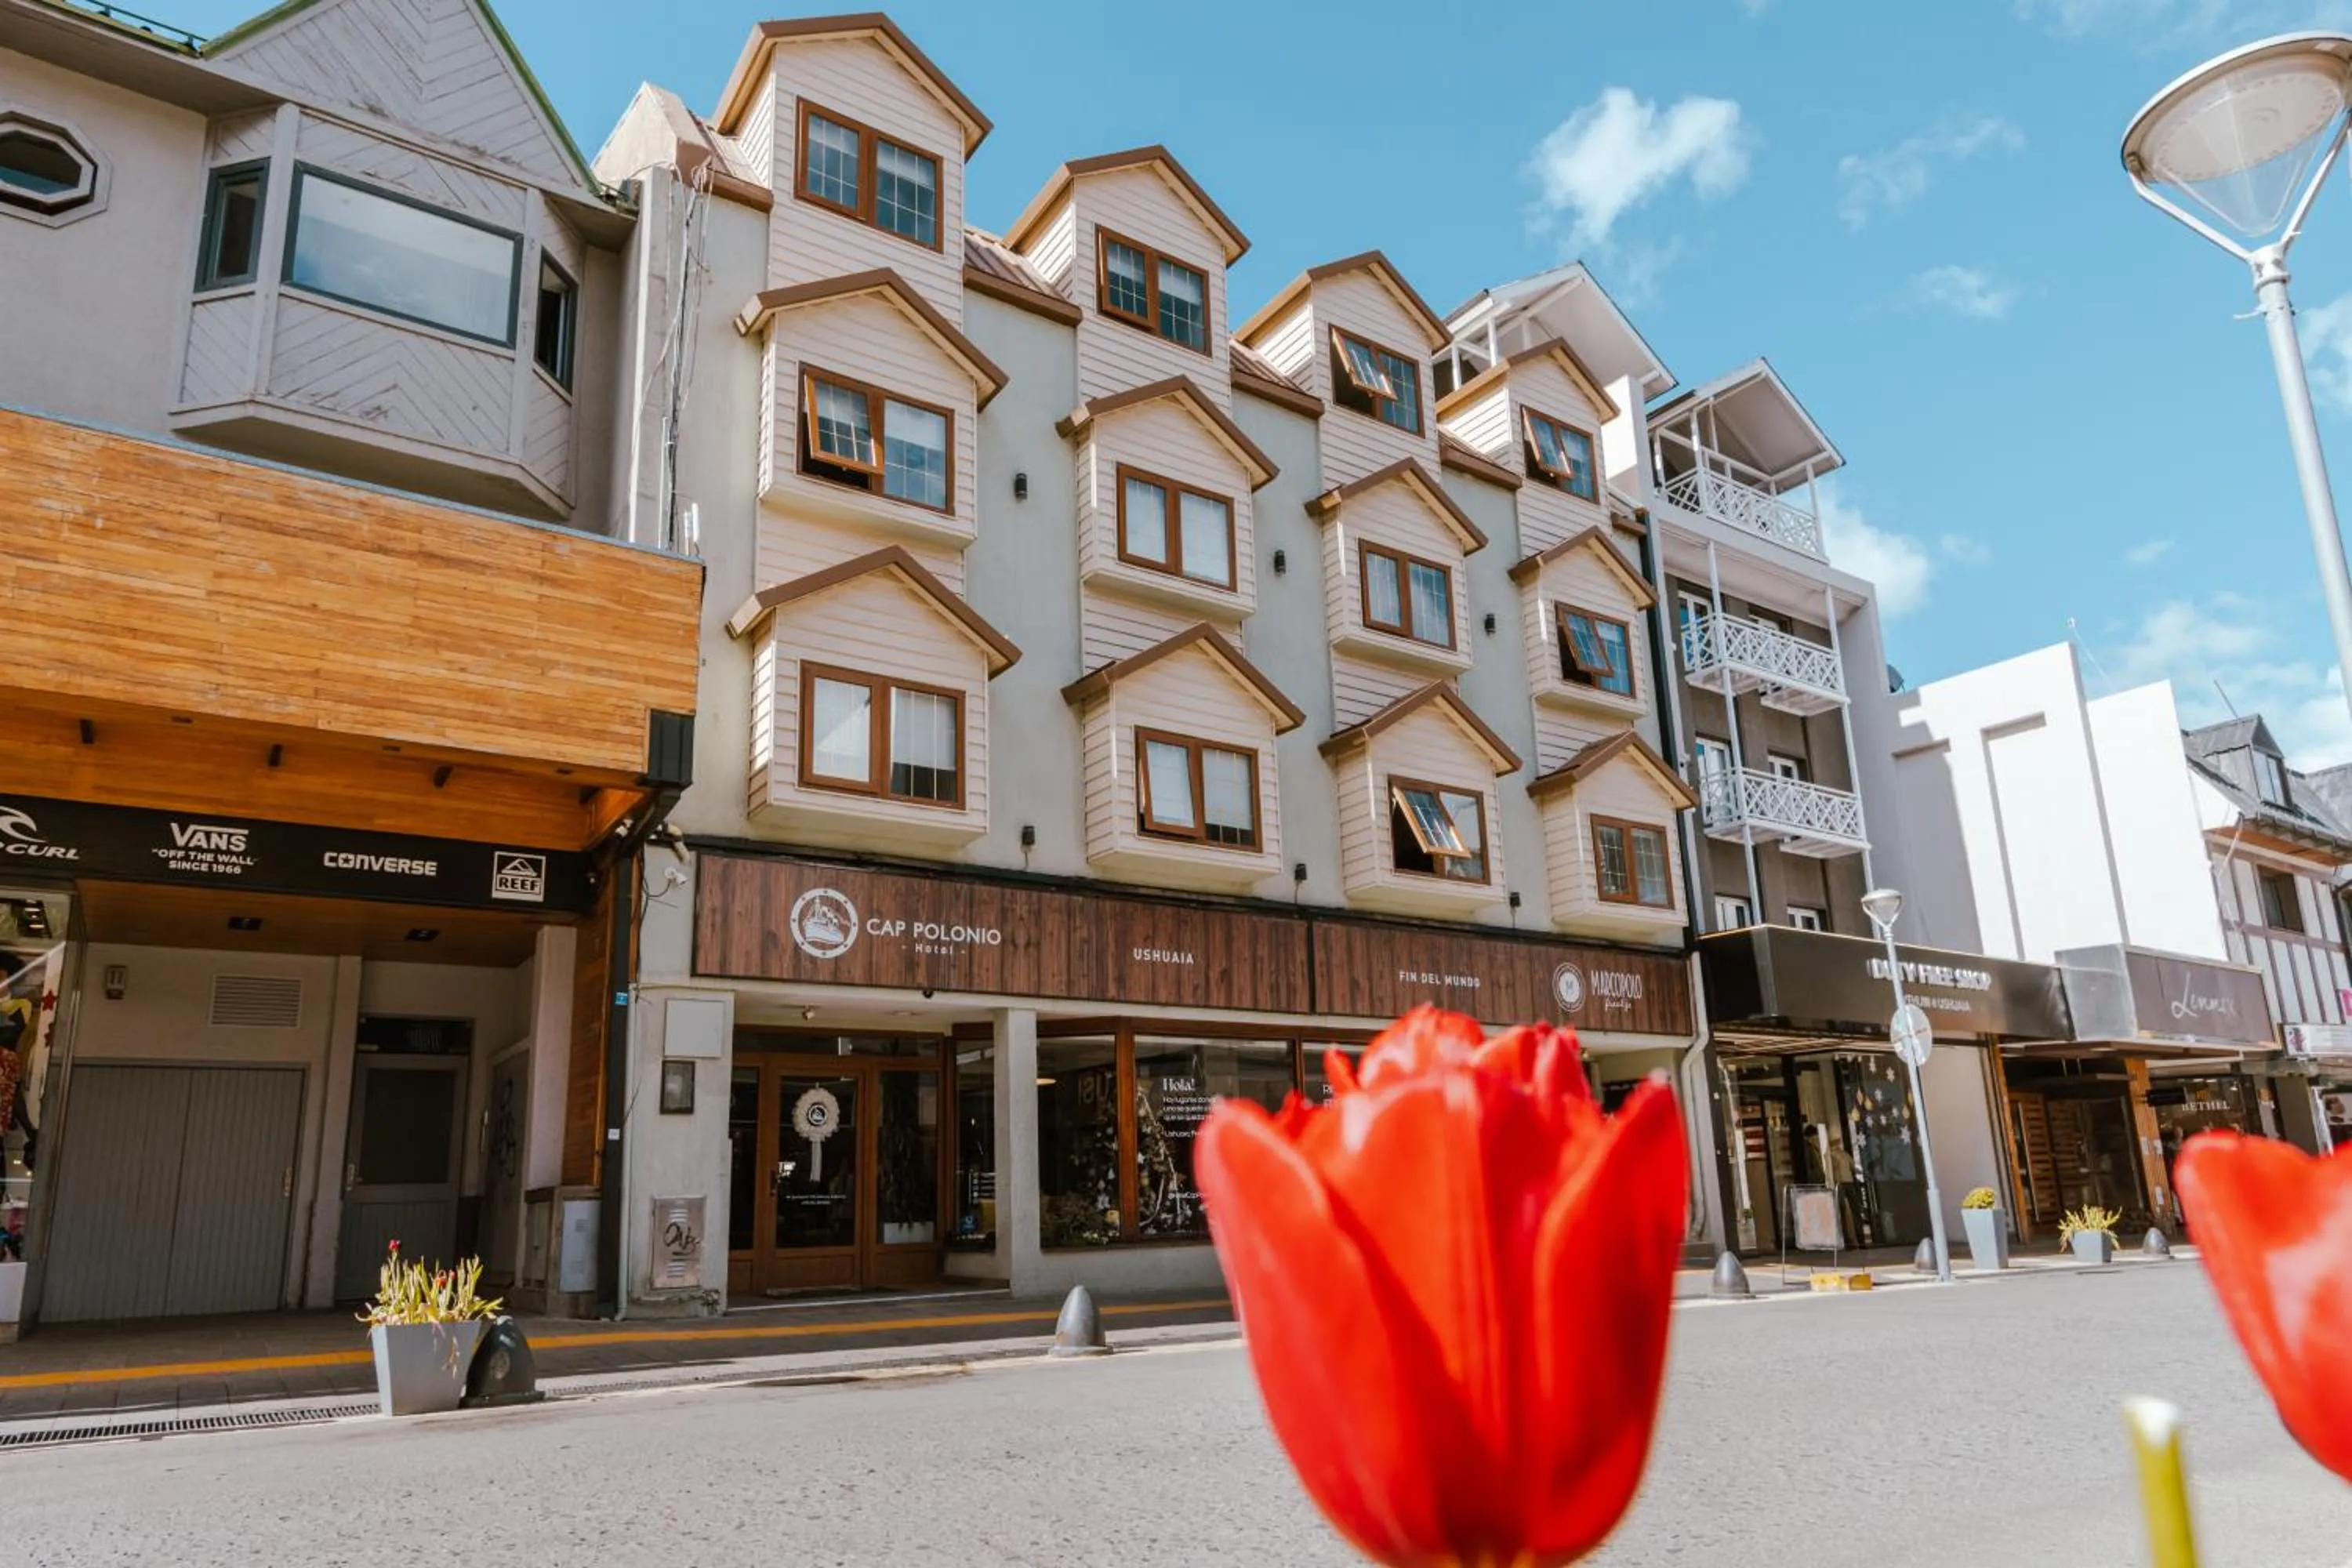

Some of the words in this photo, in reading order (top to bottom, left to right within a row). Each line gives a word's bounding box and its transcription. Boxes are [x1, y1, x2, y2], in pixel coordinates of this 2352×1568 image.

[170, 822, 249, 851] VANS
[5, 843, 79, 860] CURL
[189, 851, 214, 862] THE
[169, 860, 209, 872] SINCE
[212, 862, 242, 874] 1966
[323, 851, 438, 877] CONVERSE
[499, 877, 541, 892] REEF
[866, 918, 906, 937] CAP
[913, 923, 1002, 946] POLONIO
[915, 943, 953, 954] Hotel
[1133, 947, 1194, 965] USHUAIA
[1399, 970, 1417, 982] FIN
[1421, 972, 1441, 985] DEL
[1444, 975, 1481, 988] MUNDO
[1917, 963, 1954, 987] FREE
[1591, 970, 1642, 1000] MARCOPOLO
[1163, 1078, 1195, 1092] Hola!
